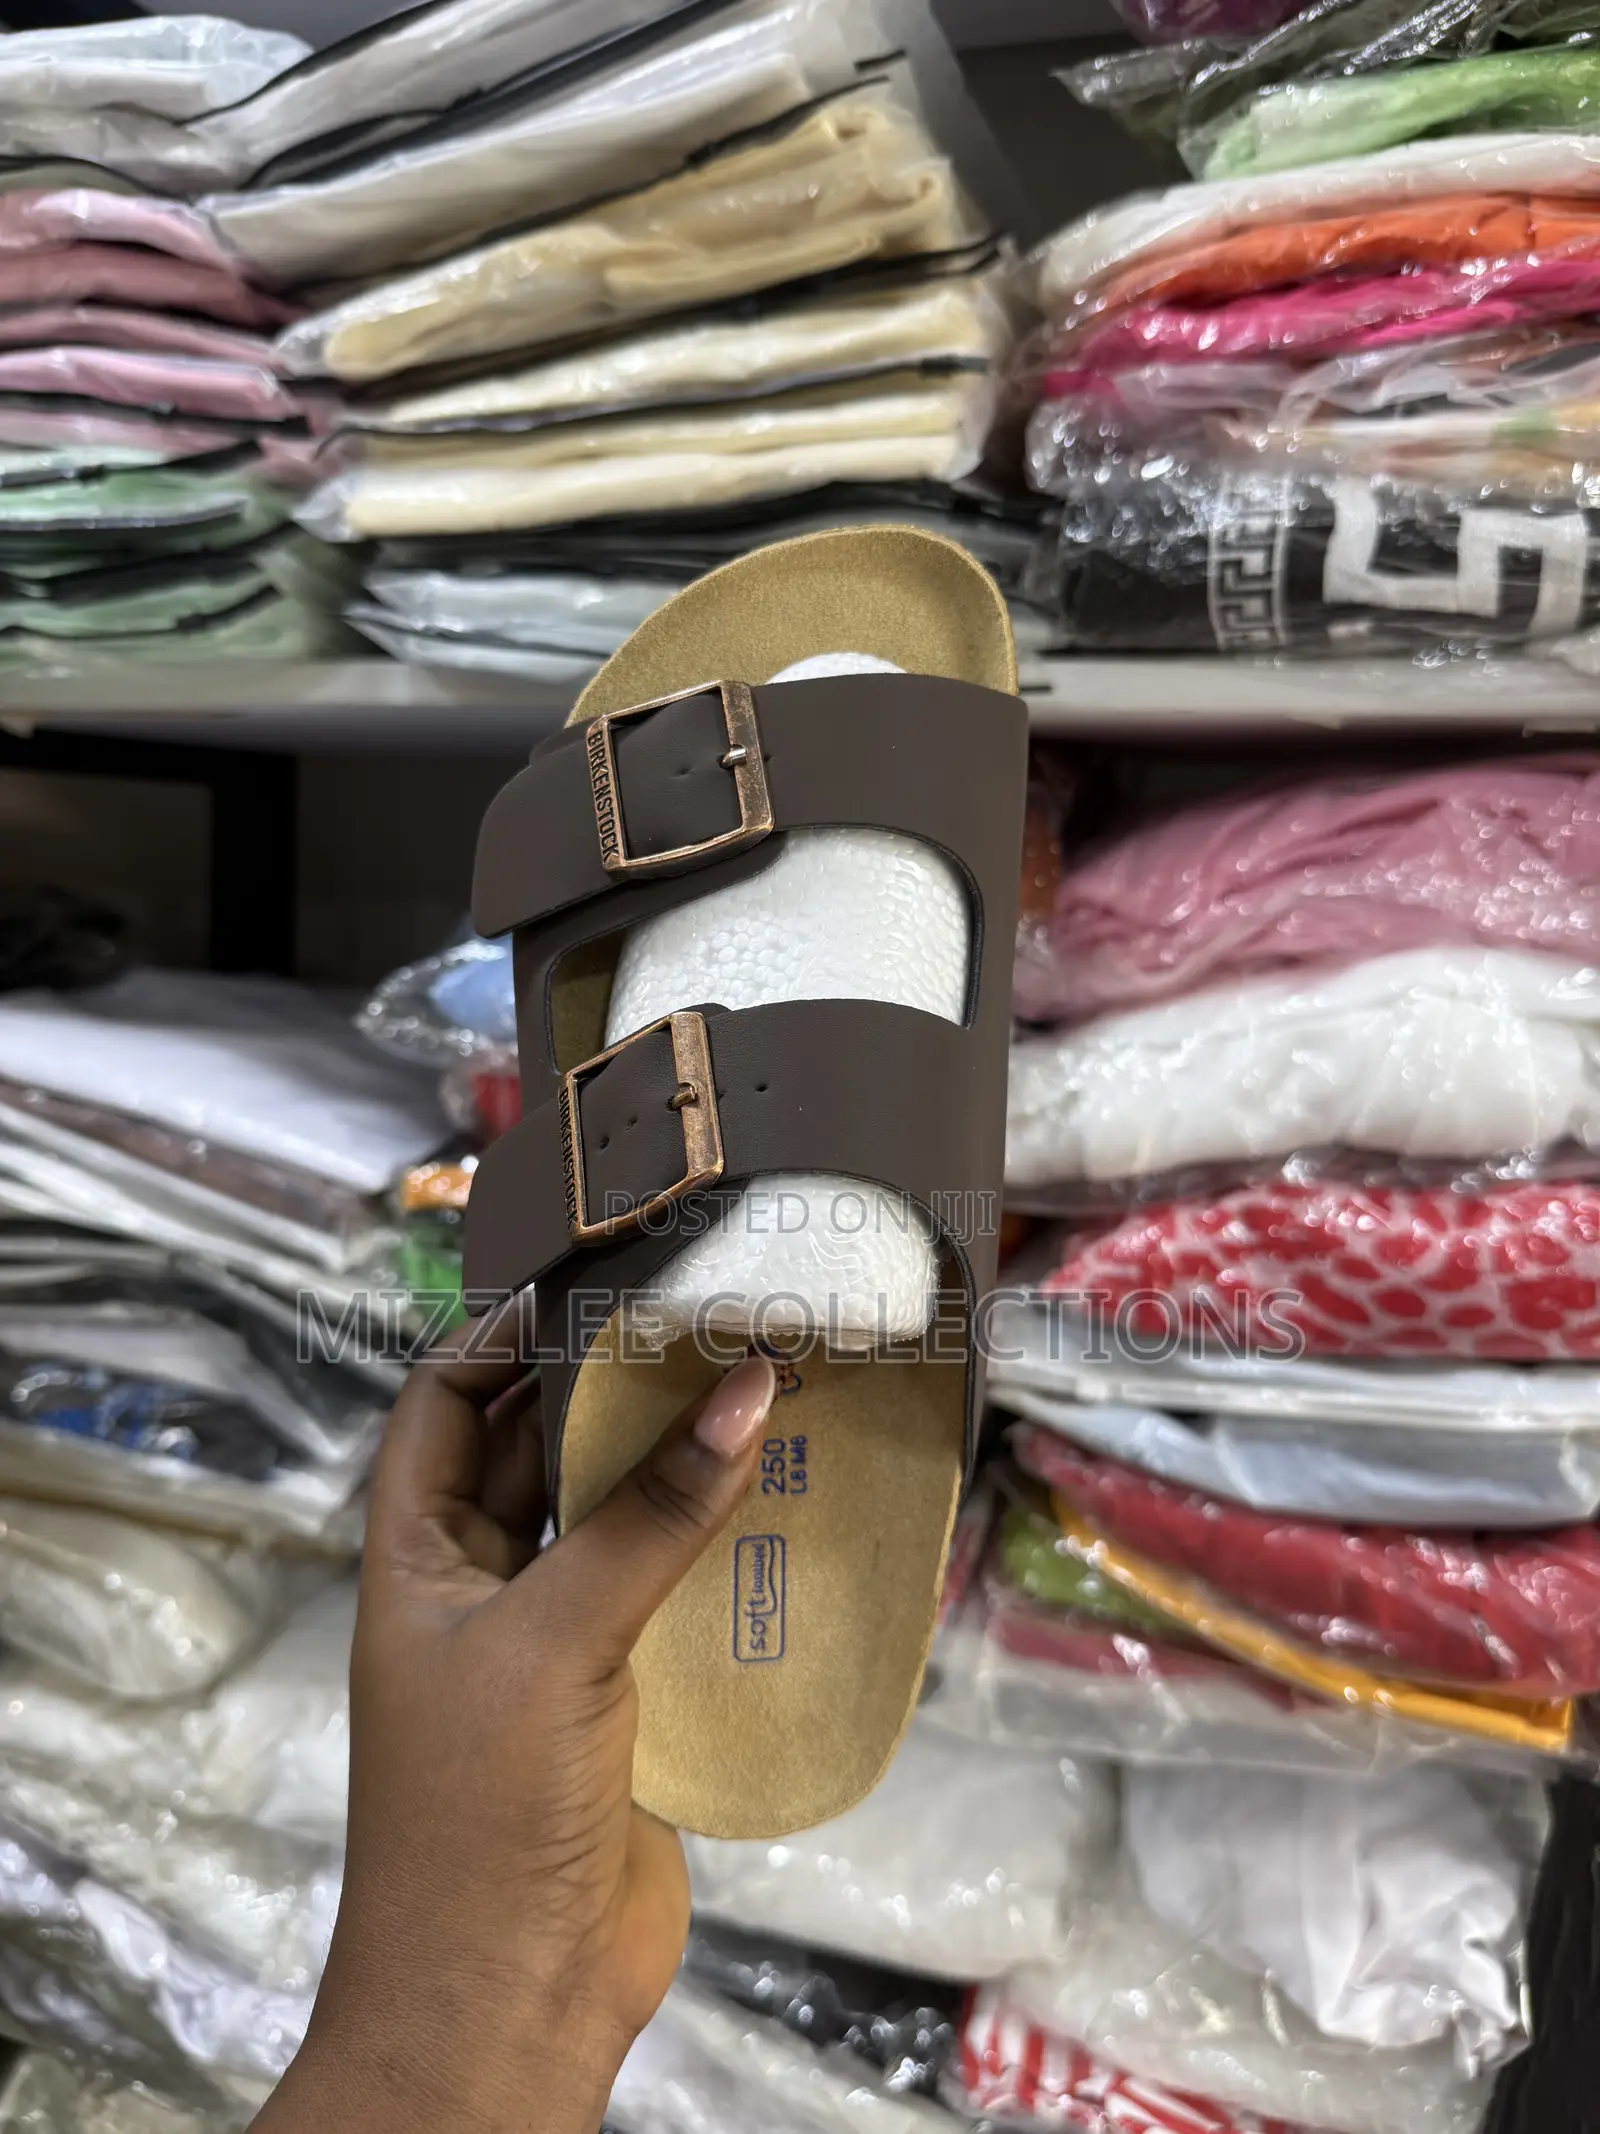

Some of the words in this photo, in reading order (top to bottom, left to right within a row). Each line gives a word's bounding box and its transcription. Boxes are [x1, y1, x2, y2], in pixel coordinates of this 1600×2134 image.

[587, 730, 620, 863] BIRKENSTOCK
[558, 1086, 579, 1229] BIRKENSTOCK
[760, 1438, 786, 1495] 250
